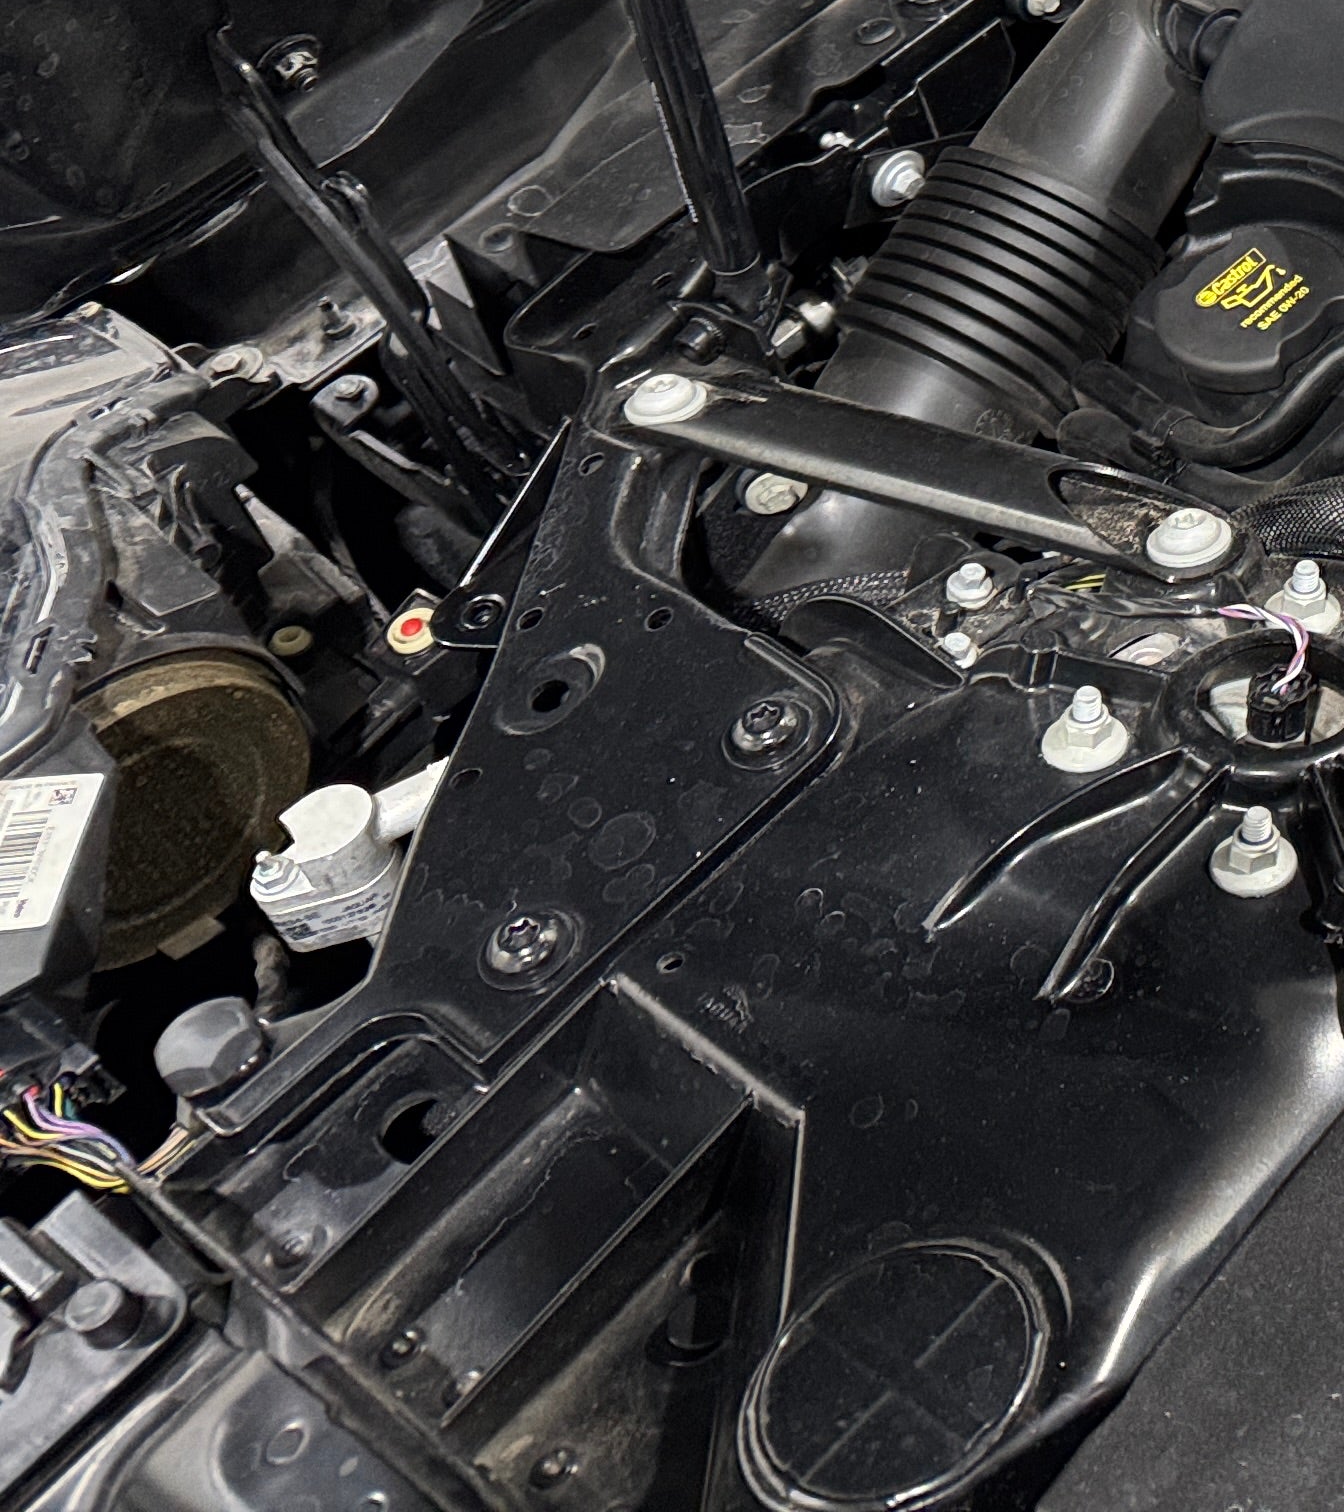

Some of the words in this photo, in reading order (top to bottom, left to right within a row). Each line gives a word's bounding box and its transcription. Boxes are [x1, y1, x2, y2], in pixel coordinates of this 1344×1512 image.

[1211, 255, 1259, 296] Castrol
[1240, 274, 1304, 328] recommended
[1257, 310, 1282, 331] SAE
[1278, 286, 1310, 313] 0W-20
